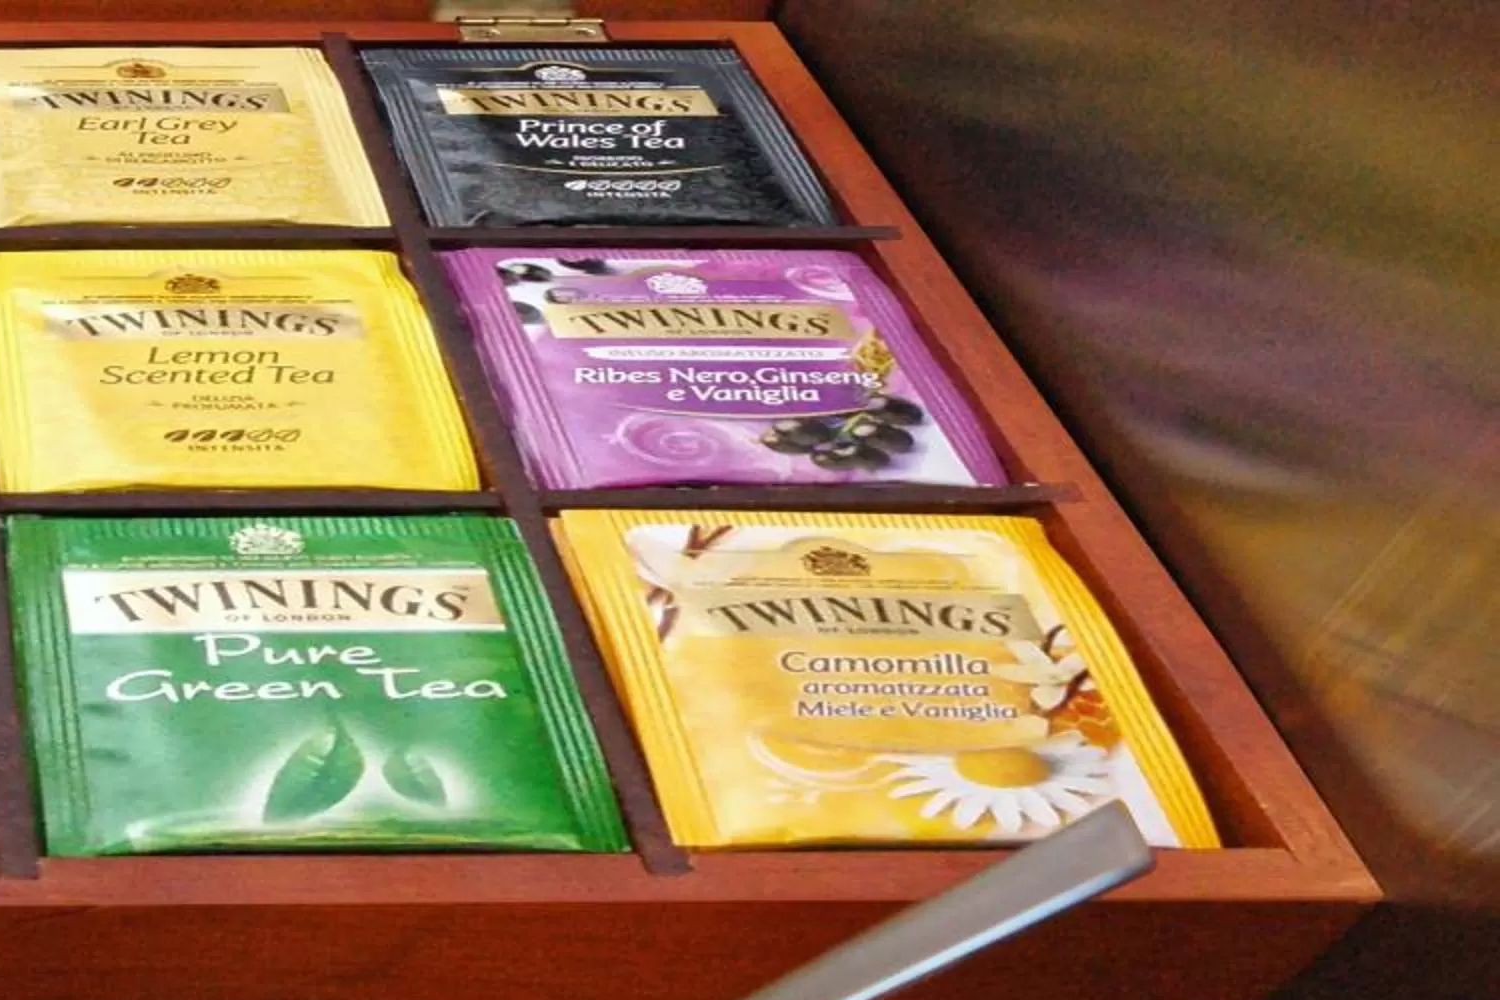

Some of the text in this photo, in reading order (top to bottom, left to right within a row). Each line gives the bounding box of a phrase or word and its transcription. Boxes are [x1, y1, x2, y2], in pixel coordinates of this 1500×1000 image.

[29, 88, 270, 111] TWININGS
[460, 89, 696, 113] TWININGS
[77, 117, 238, 135] Earl Grey
[519, 118, 667, 136] Prince of
[135, 131, 192, 145] Tea
[514, 134, 686, 150] Wales Tea
[66, 308, 341, 337] TWININGS
[569, 306, 831, 336] TWININGS
[147, 346, 280, 366] Lemon
[99, 364, 335, 386] Scented Tea
[574, 367, 662, 385] Ribes
[666, 386, 821, 405] e Vaniglia
[94, 577, 470, 621] TWININGS
[224, 613, 352, 622] OF LONDON
[707, 595, 1013, 637] TWININGS
[193, 632, 383, 667] Pure
[780, 651, 991, 677] Camomilla
[106, 667, 508, 702] Green Tea
[802, 680, 991, 698] aromatizzata
[797, 701, 1019, 722] Miele e Vaniglia
